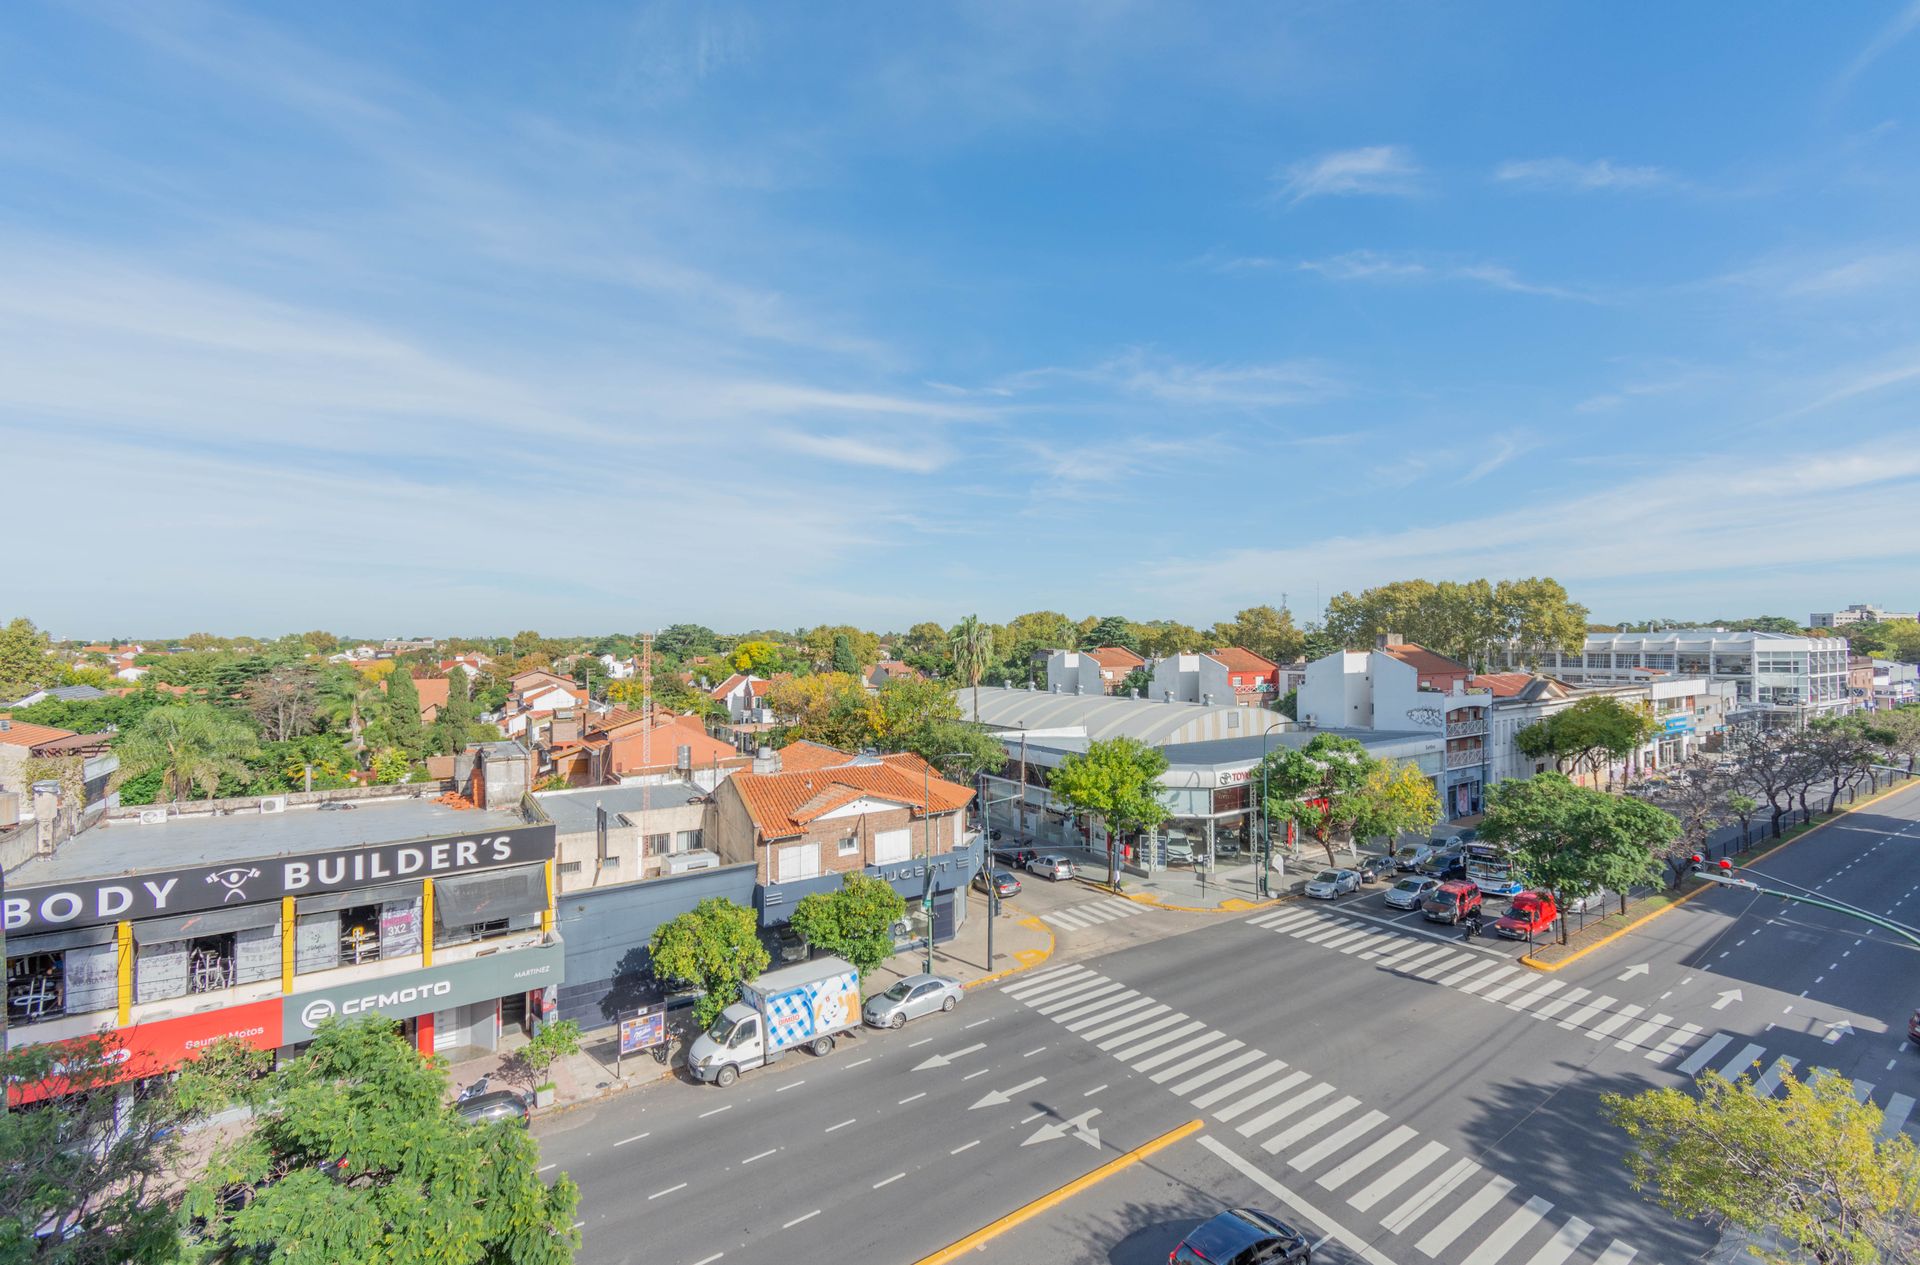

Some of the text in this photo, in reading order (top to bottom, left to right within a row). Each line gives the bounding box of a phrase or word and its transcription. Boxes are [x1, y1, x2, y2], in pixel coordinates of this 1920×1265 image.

[1231, 771, 1252, 781] TOYO
[4, 878, 179, 930] BODY
[513, 965, 551, 979] MARTINEZ
[341, 980, 451, 1015] CFMOTO
[185, 1034, 226, 1050] Saum
